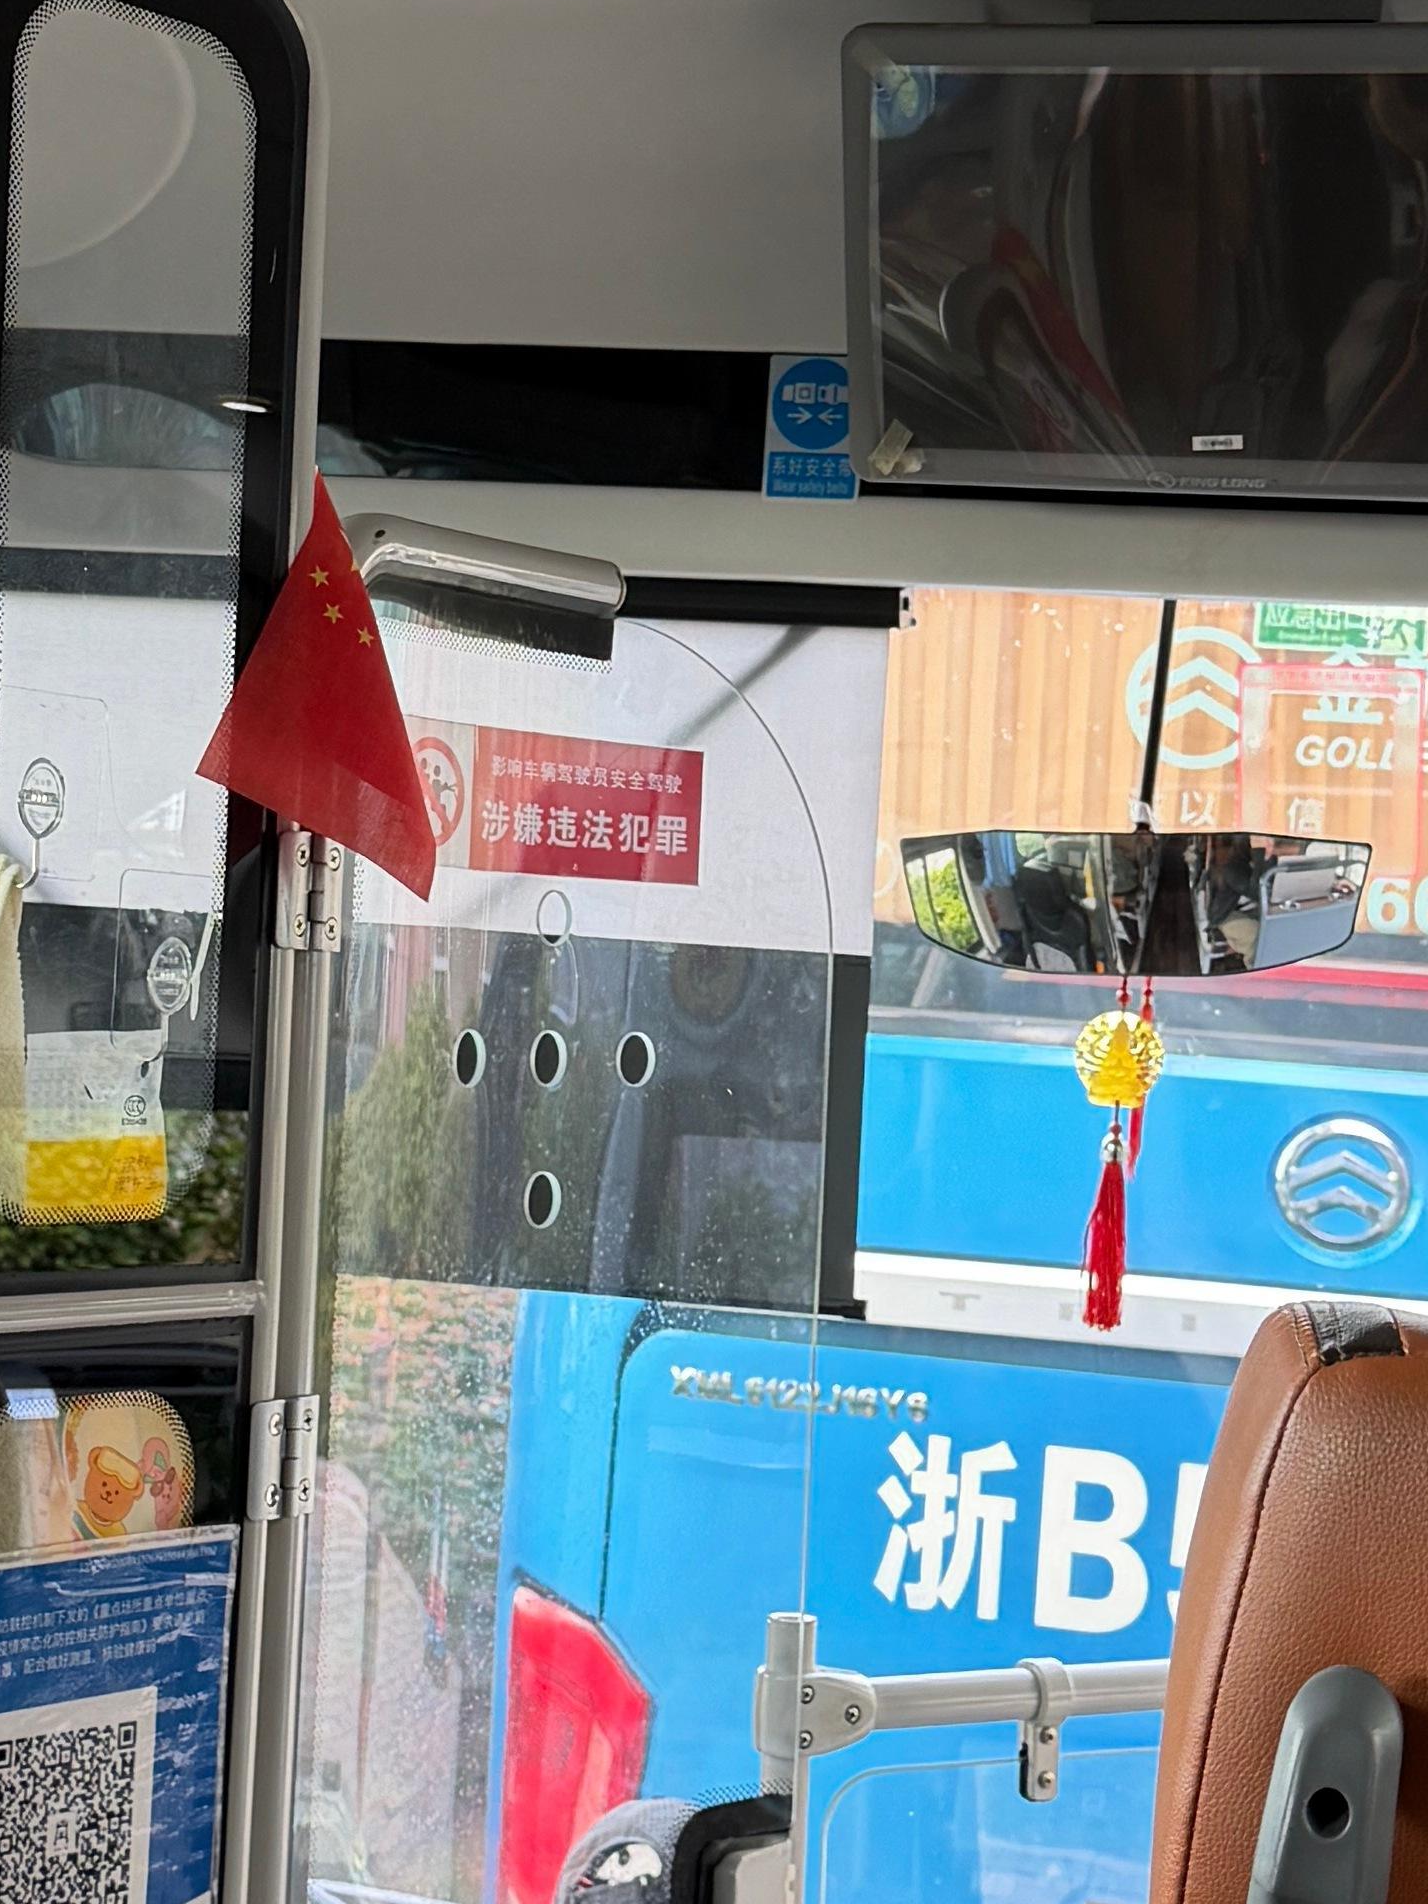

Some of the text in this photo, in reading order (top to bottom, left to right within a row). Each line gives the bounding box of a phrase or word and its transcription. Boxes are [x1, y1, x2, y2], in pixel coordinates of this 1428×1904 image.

[491, 755, 683, 795] 影响车辆驾驶员安全驾驶
[481, 799, 688, 856] 涉嫌违法犯罪
